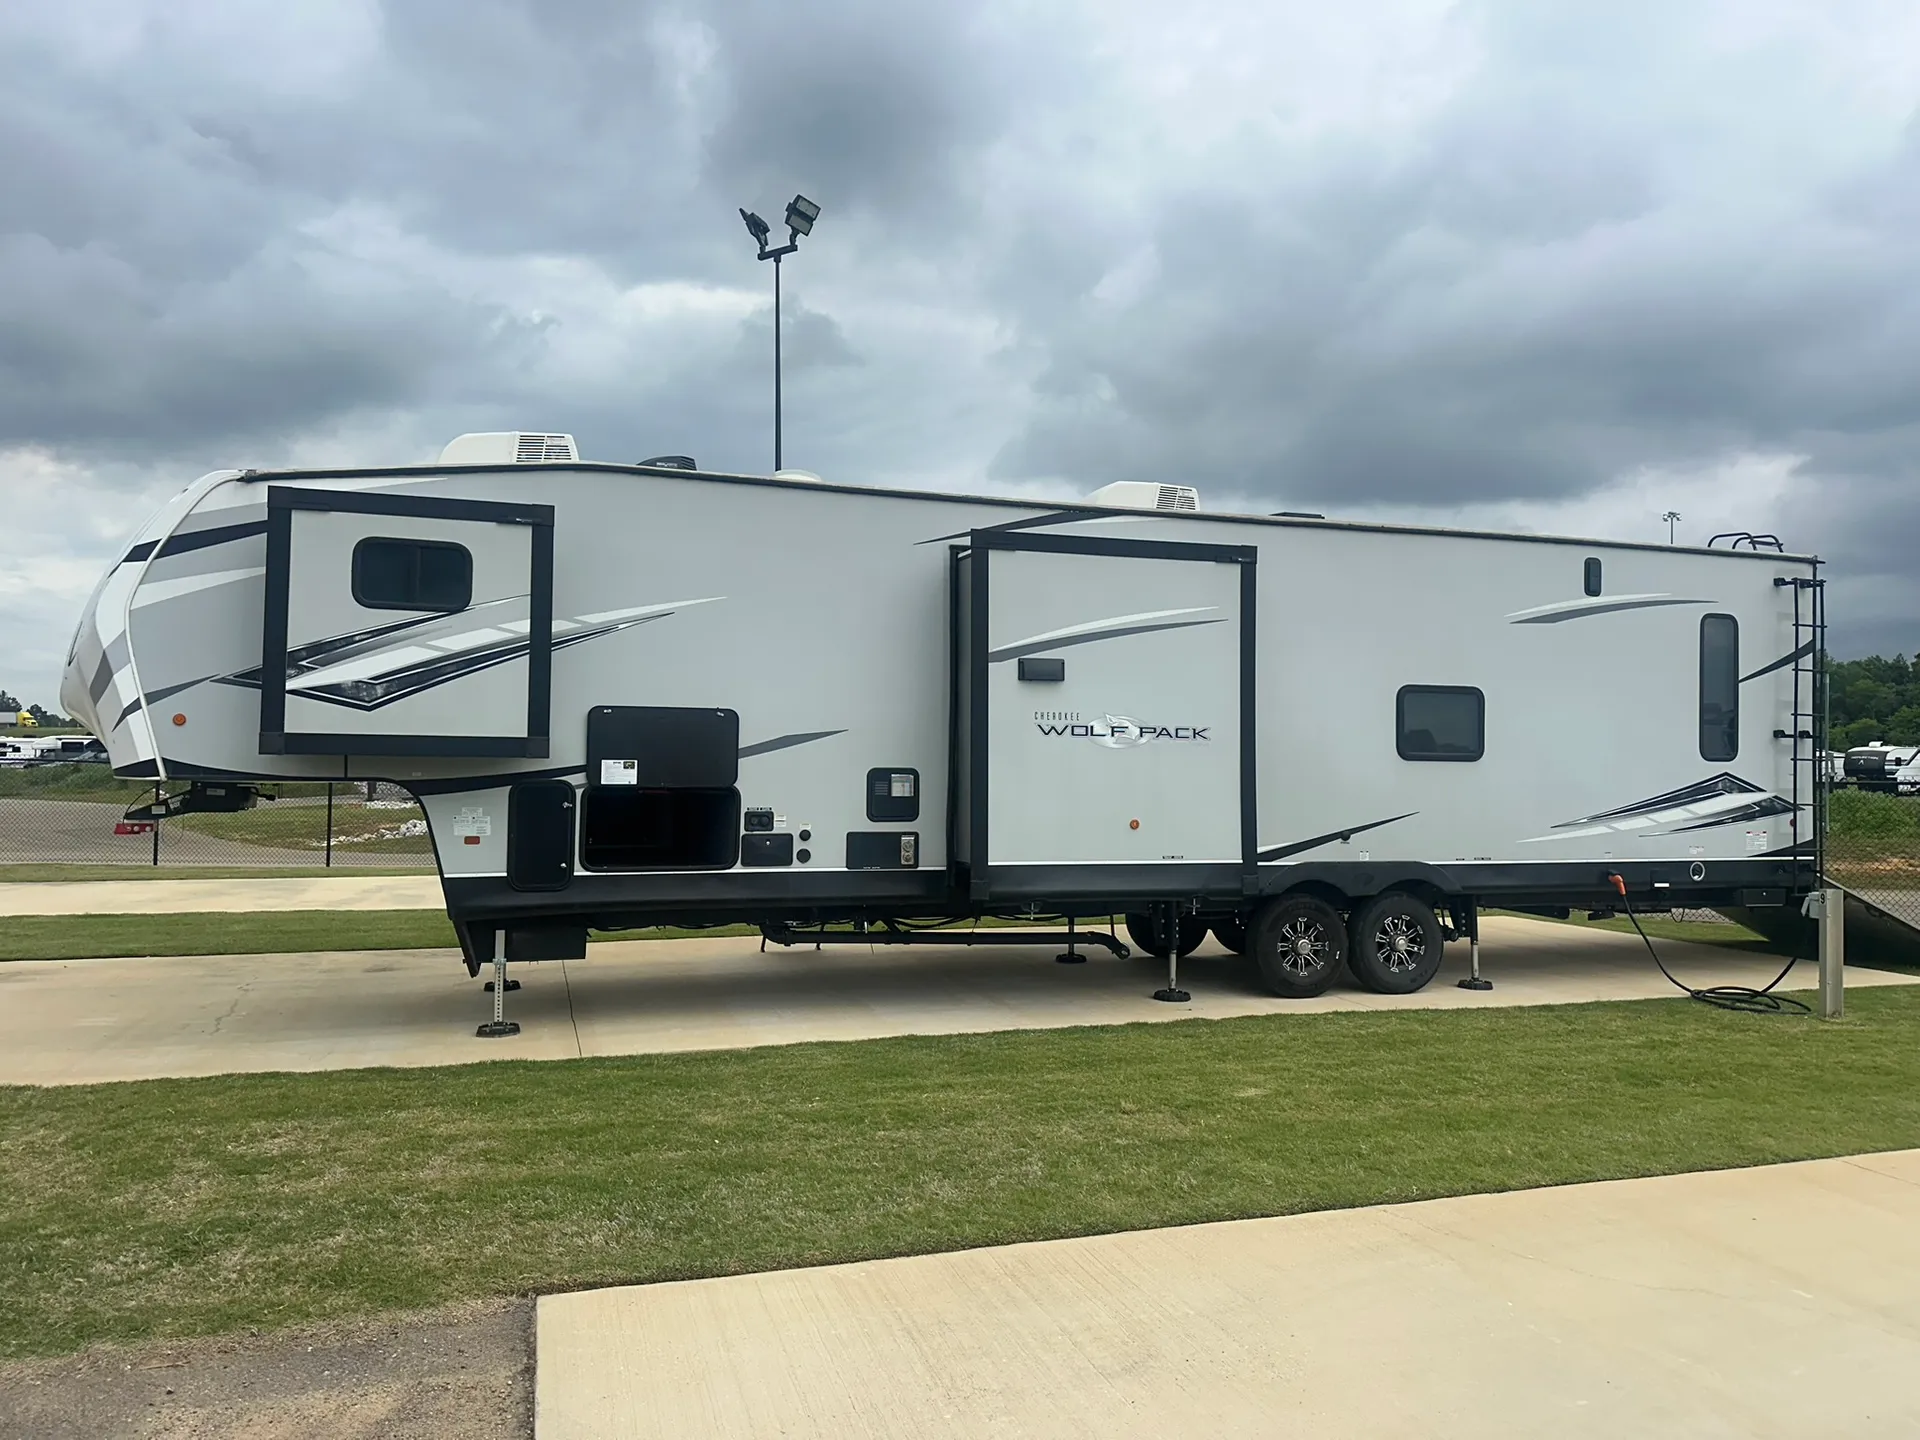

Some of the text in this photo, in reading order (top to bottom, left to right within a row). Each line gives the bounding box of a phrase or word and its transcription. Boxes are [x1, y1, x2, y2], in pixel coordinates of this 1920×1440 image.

[1034, 711, 1080, 721] CHEROKEE
[1036, 724, 1211, 741] WOLF PACK
[1820, 893, 1826, 904] 9
